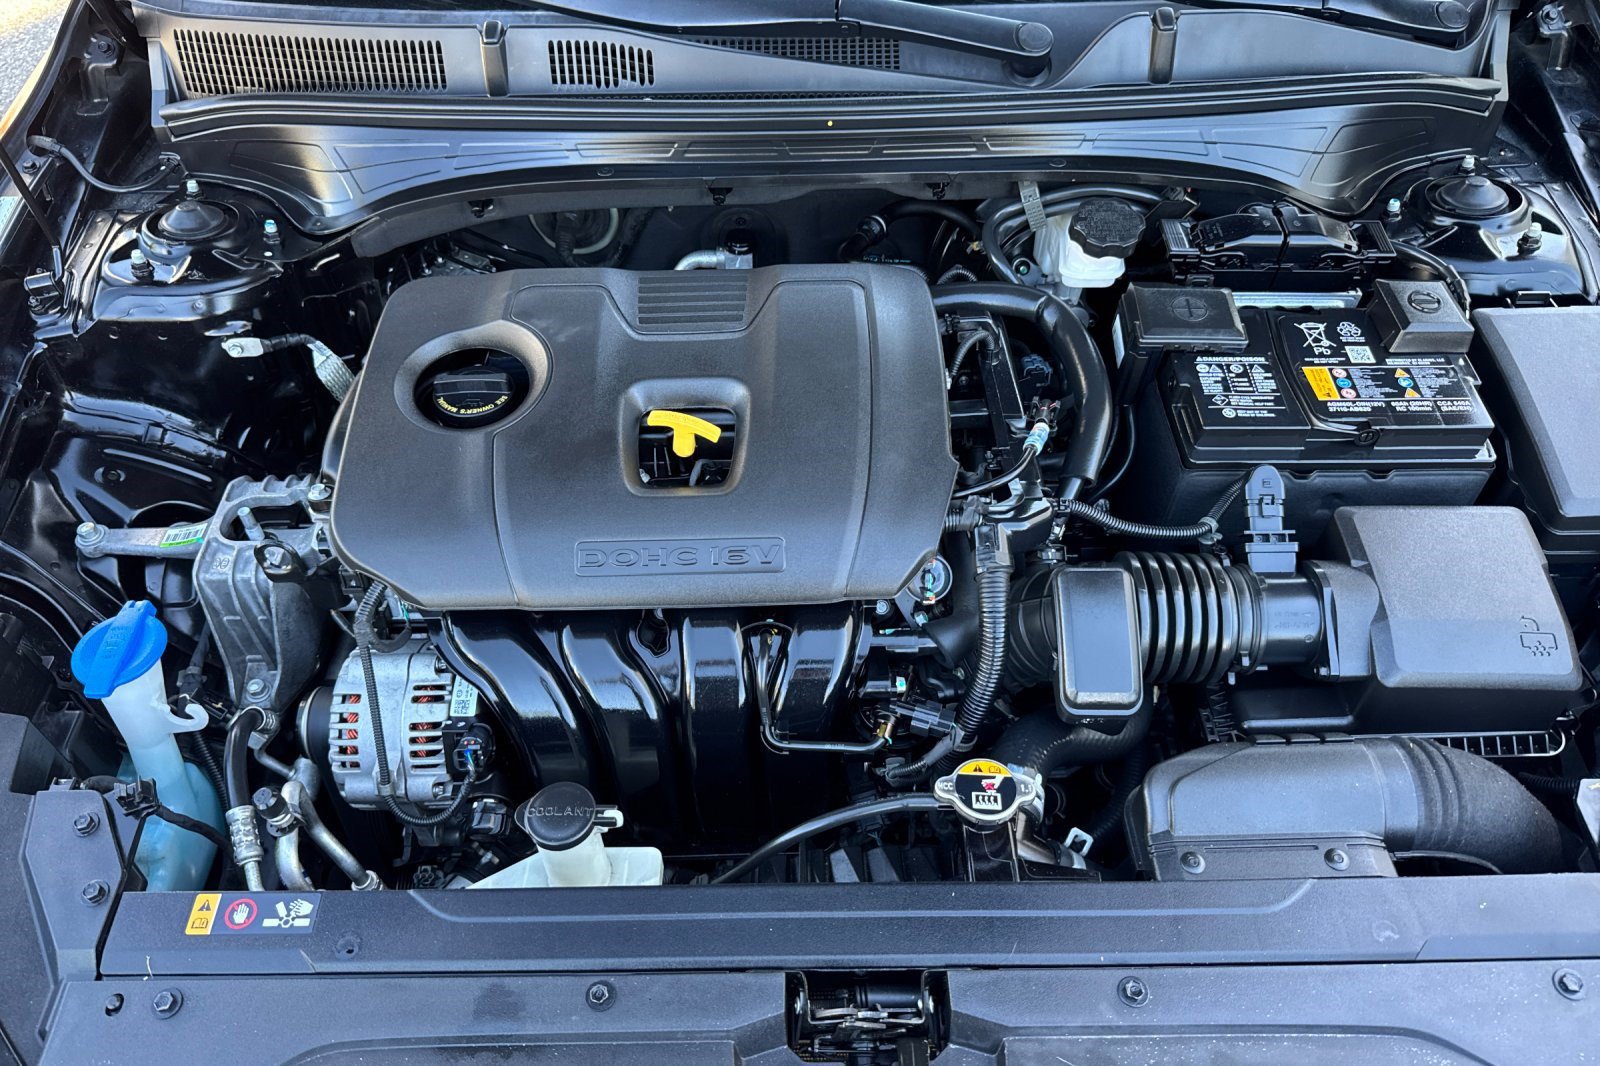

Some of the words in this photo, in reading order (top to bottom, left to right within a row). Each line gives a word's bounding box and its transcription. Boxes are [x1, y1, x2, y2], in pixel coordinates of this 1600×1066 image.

[1313, 347, 1331, 355] Pb
[437, 396, 459, 413] MANUAL
[495, 395, 508, 405] SEE
[459, 403, 495, 414] OWNER'S
[578, 547, 698, 568] DOHC
[709, 544, 781, 566] 16V
[527, 806, 594, 818] COOLANT
